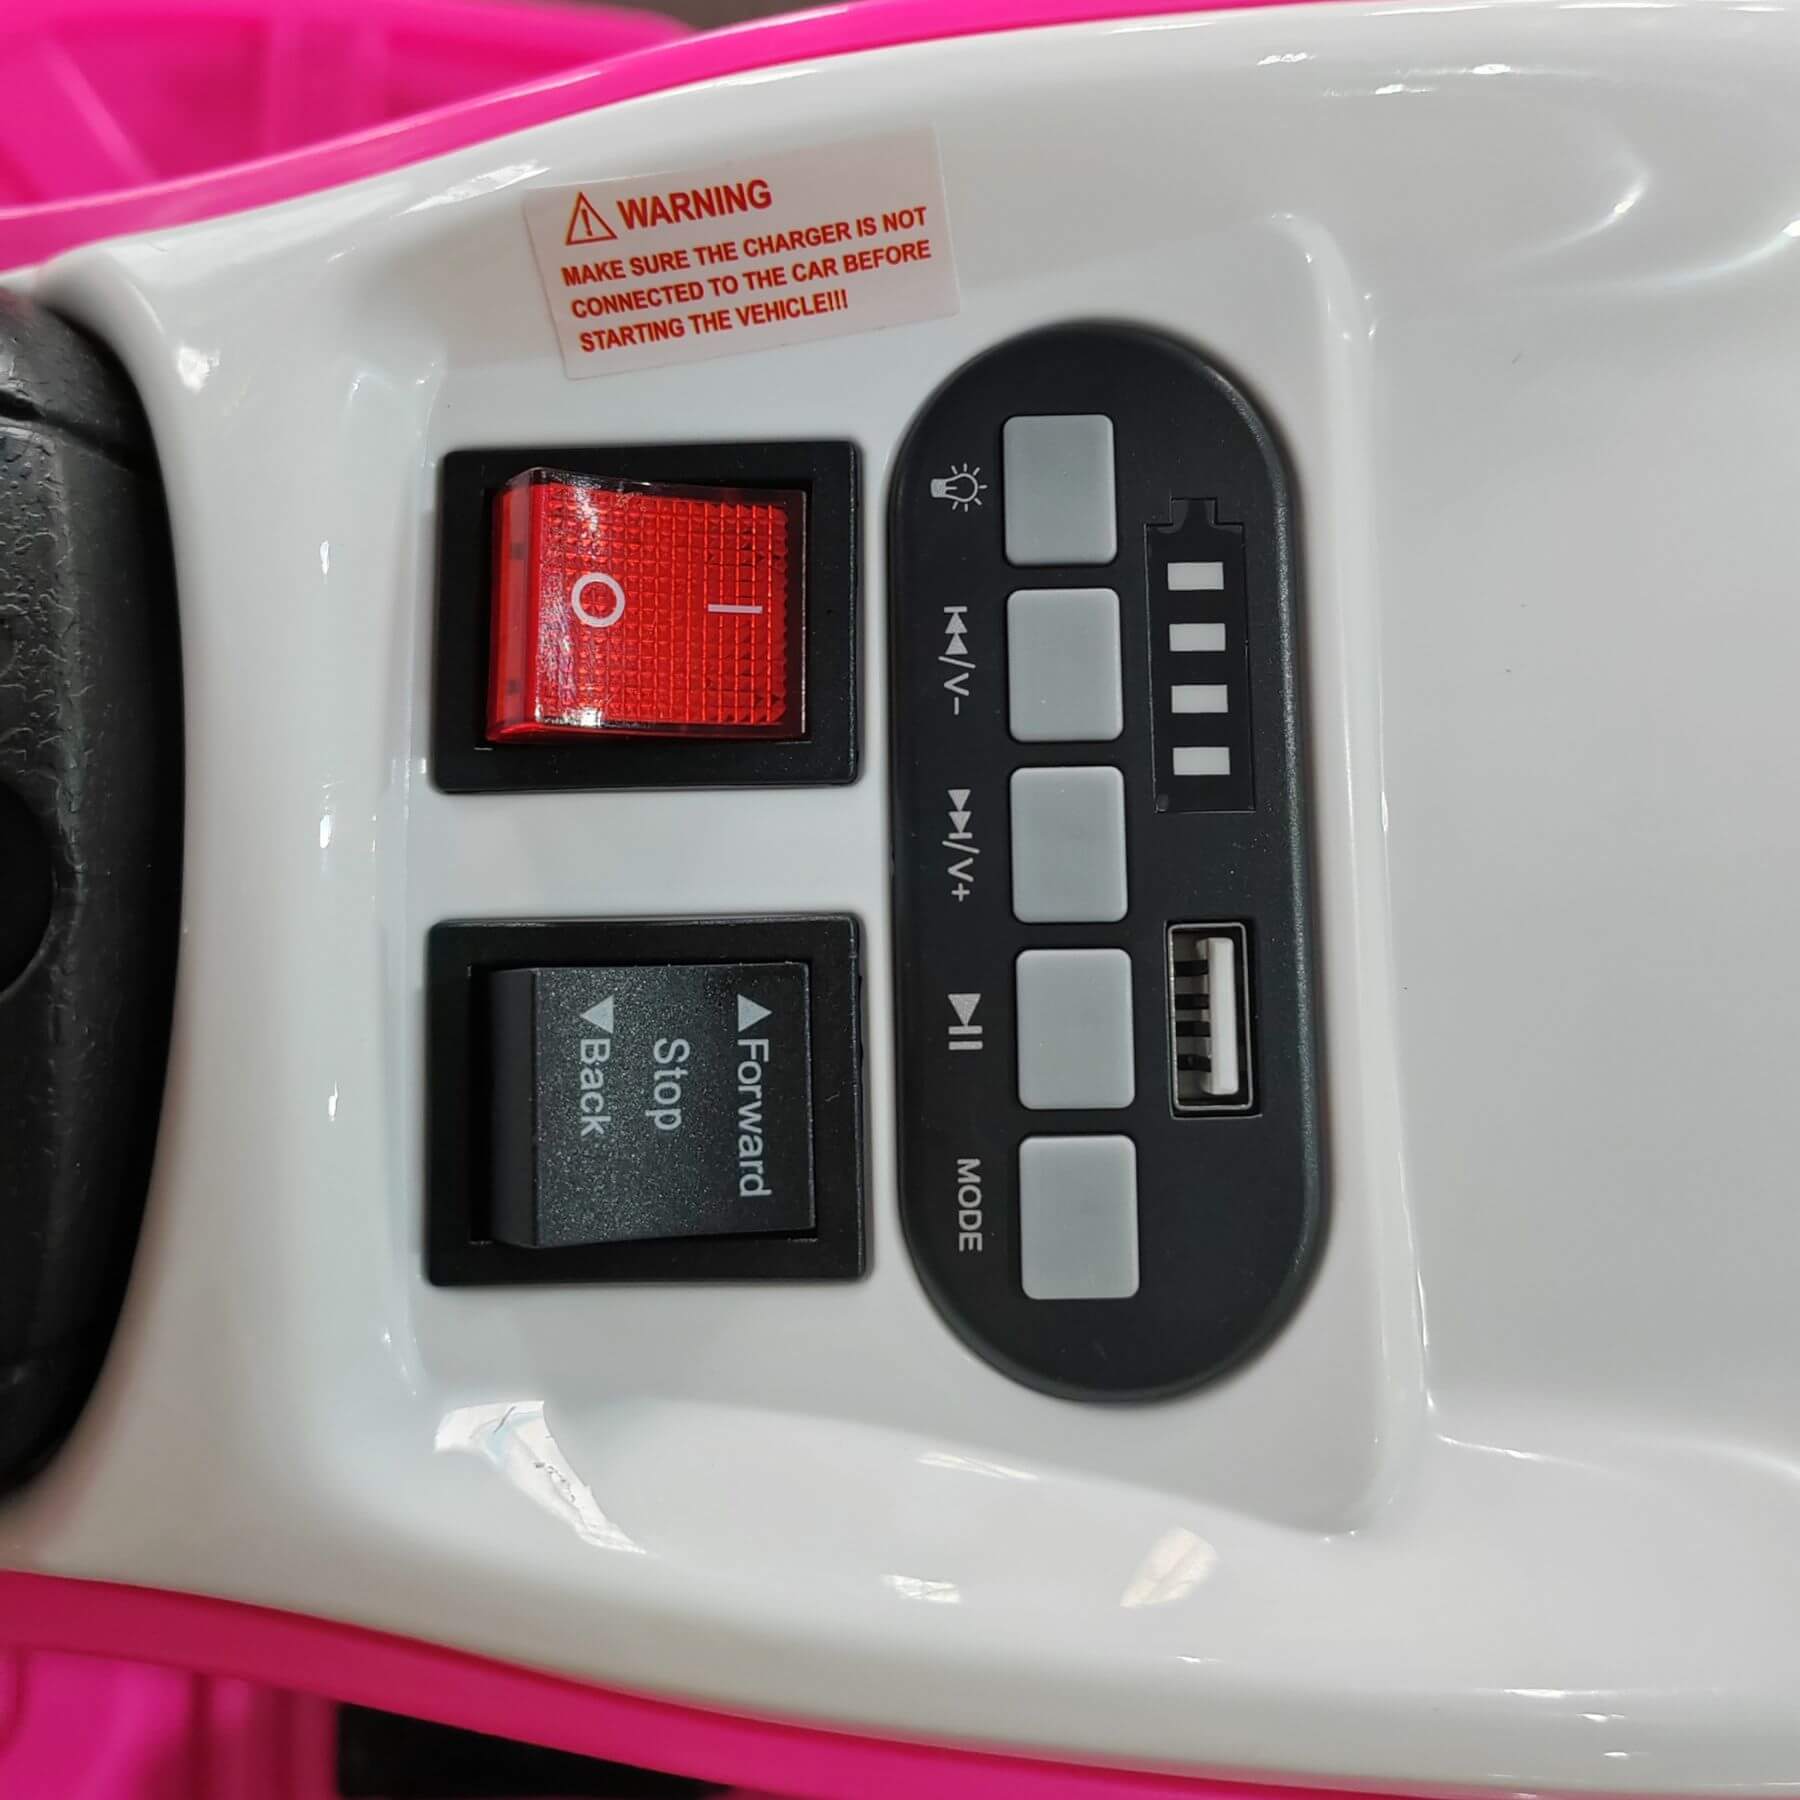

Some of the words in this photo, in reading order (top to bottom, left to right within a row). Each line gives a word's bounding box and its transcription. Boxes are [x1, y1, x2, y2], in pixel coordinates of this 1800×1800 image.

[561, 260, 626, 287] MAKE
[630, 249, 690, 277] SURE
[693, 242, 738, 268] THE
[743, 222, 851, 259] CHARGER
[855, 217, 877, 238] IS
[882, 207, 927, 232] NOT
[616, 178, 772, 230] WARNING
[571, 281, 704, 319] CONNECTED
[708, 273, 739, 297] TO
[743, 266, 788, 291] THE
[792, 257, 836, 283] CAR
[843, 240, 931, 274] BEFORE
[579, 316, 686, 352] STARTING
[692, 307, 732, 333] THE
[735, 289, 848, 326] VEHICLE!!!
[579, 1039, 611, 1137] Back
[645, 1038, 689, 1130] Stop
[737, 1039, 772, 1197] Forward
[957, 1159, 982, 1252] MODE
